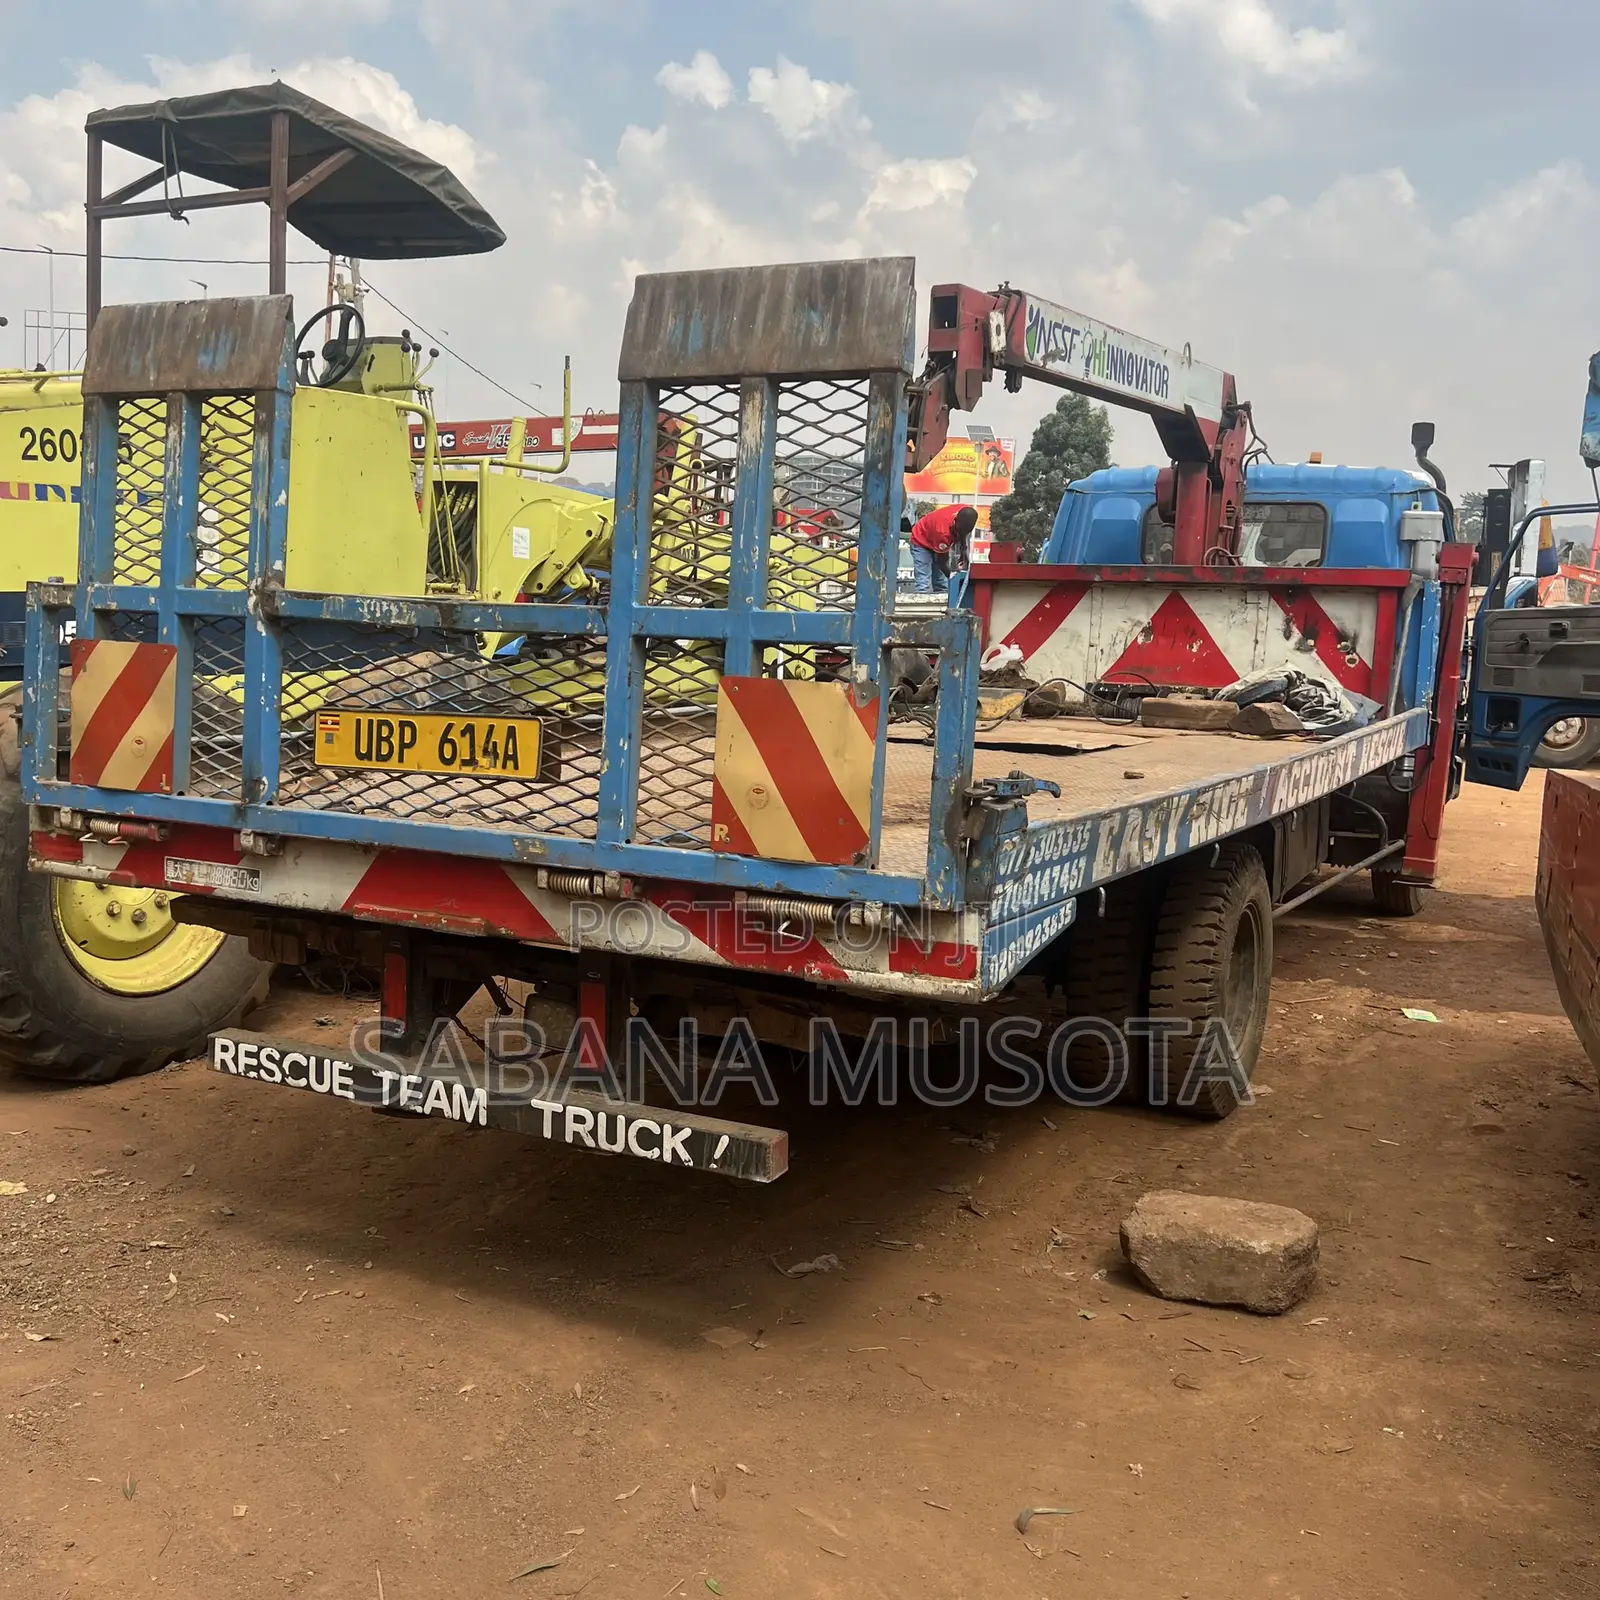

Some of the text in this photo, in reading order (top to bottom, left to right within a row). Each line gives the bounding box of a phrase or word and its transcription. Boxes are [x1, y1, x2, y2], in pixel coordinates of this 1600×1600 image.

[1036, 317, 1081, 364] NSSF
[355, 717, 520, 771] UBP 614A
[213, 1036, 355, 1100] RESCUE
[371, 1069, 488, 1127] TEAM
[530, 1099, 694, 1167] TRUCK
